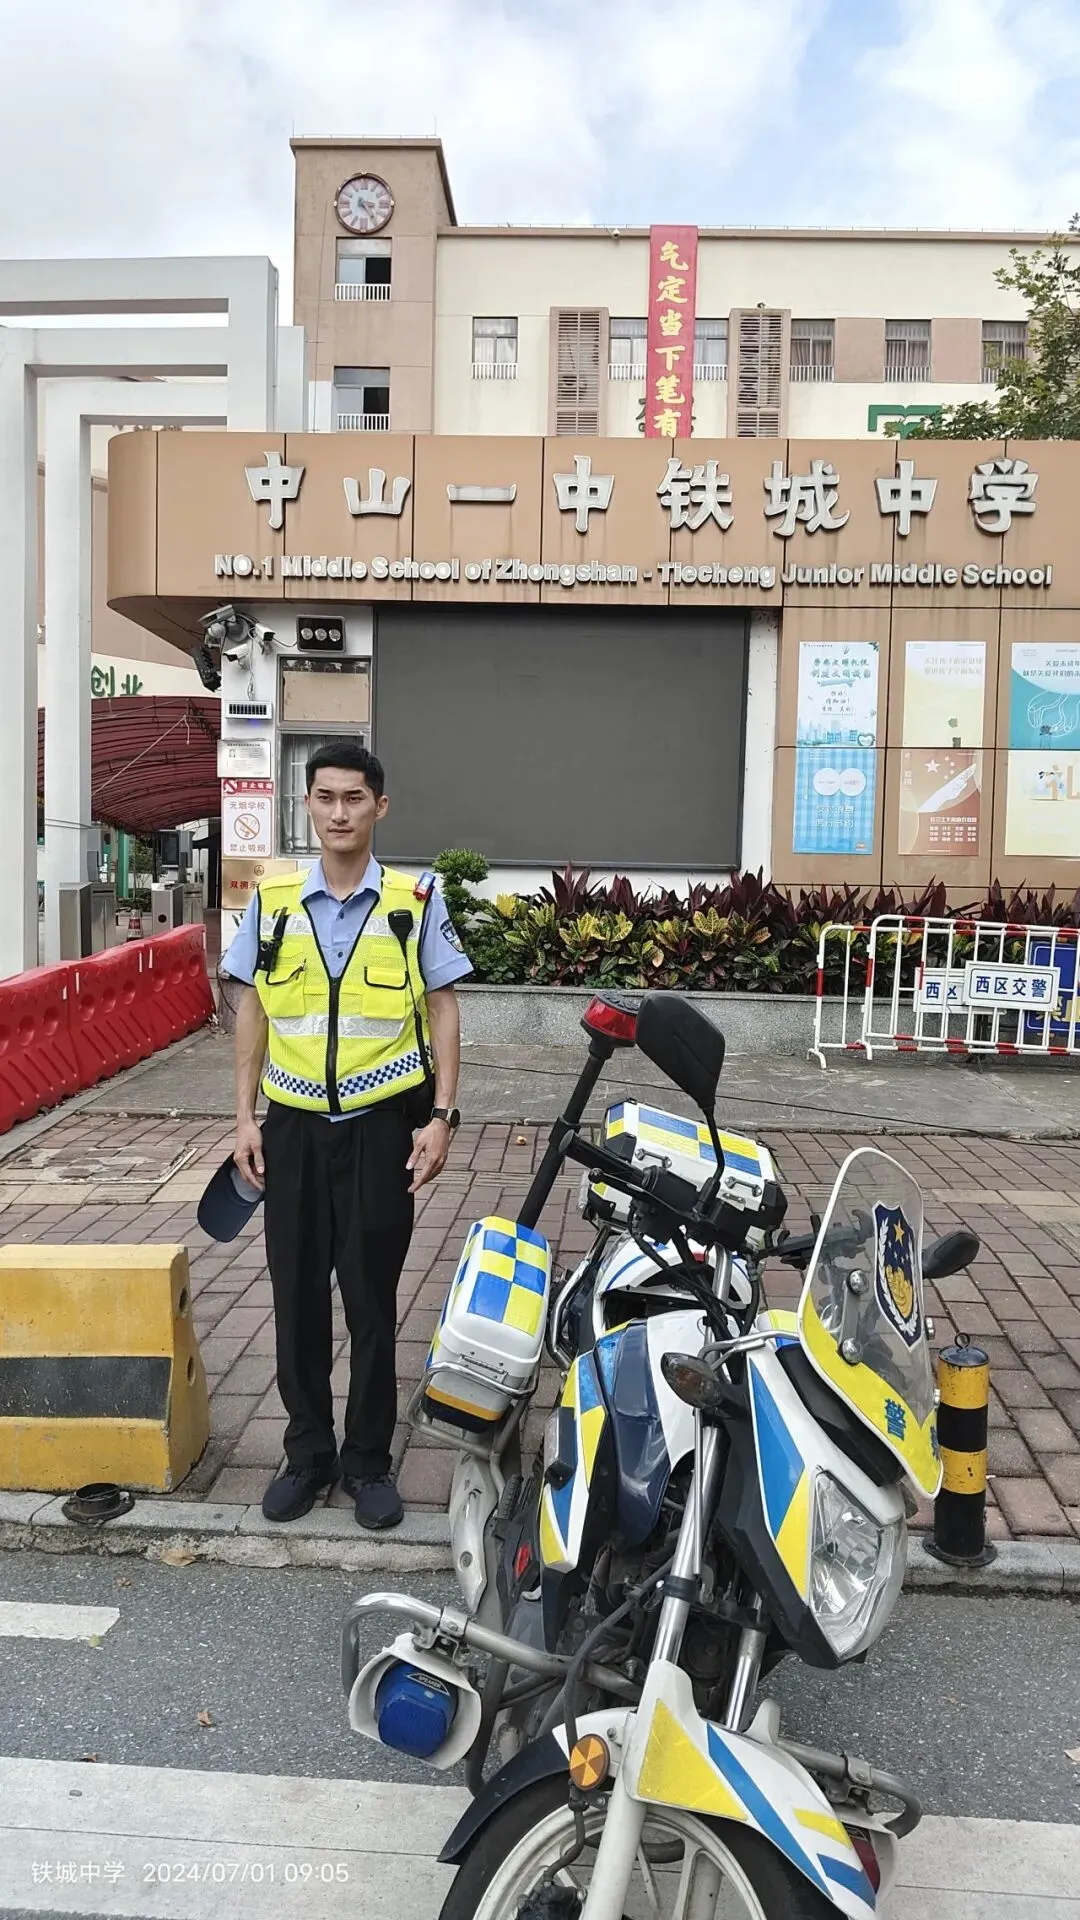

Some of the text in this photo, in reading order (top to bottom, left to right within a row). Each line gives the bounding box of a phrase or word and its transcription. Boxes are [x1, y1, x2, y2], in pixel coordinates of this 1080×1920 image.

[653, 241, 689, 437] 气定当下笔有
[243, 450, 1039, 536] 中山一中铁城中学
[214, 554, 274, 577] NO.1
[281, 555, 368, 580] Middle
[370, 556, 461, 582] School
[465, 558, 492, 582] of
[495, 559, 638, 587] Zhongshan
[656, 562, 777, 589] Tiecheng
[781, 562, 865, 587] Junior
[869, 563, 959, 588] Middle
[961, 563, 1053, 588] School
[229, 801, 266, 811] 无烟学校
[230, 844, 266, 853] 禁止吸烟
[975, 975, 1047, 998] 西区交警
[884, 1398, 906, 1441] 警
[418, 1676, 442, 1688] SPEAKER
